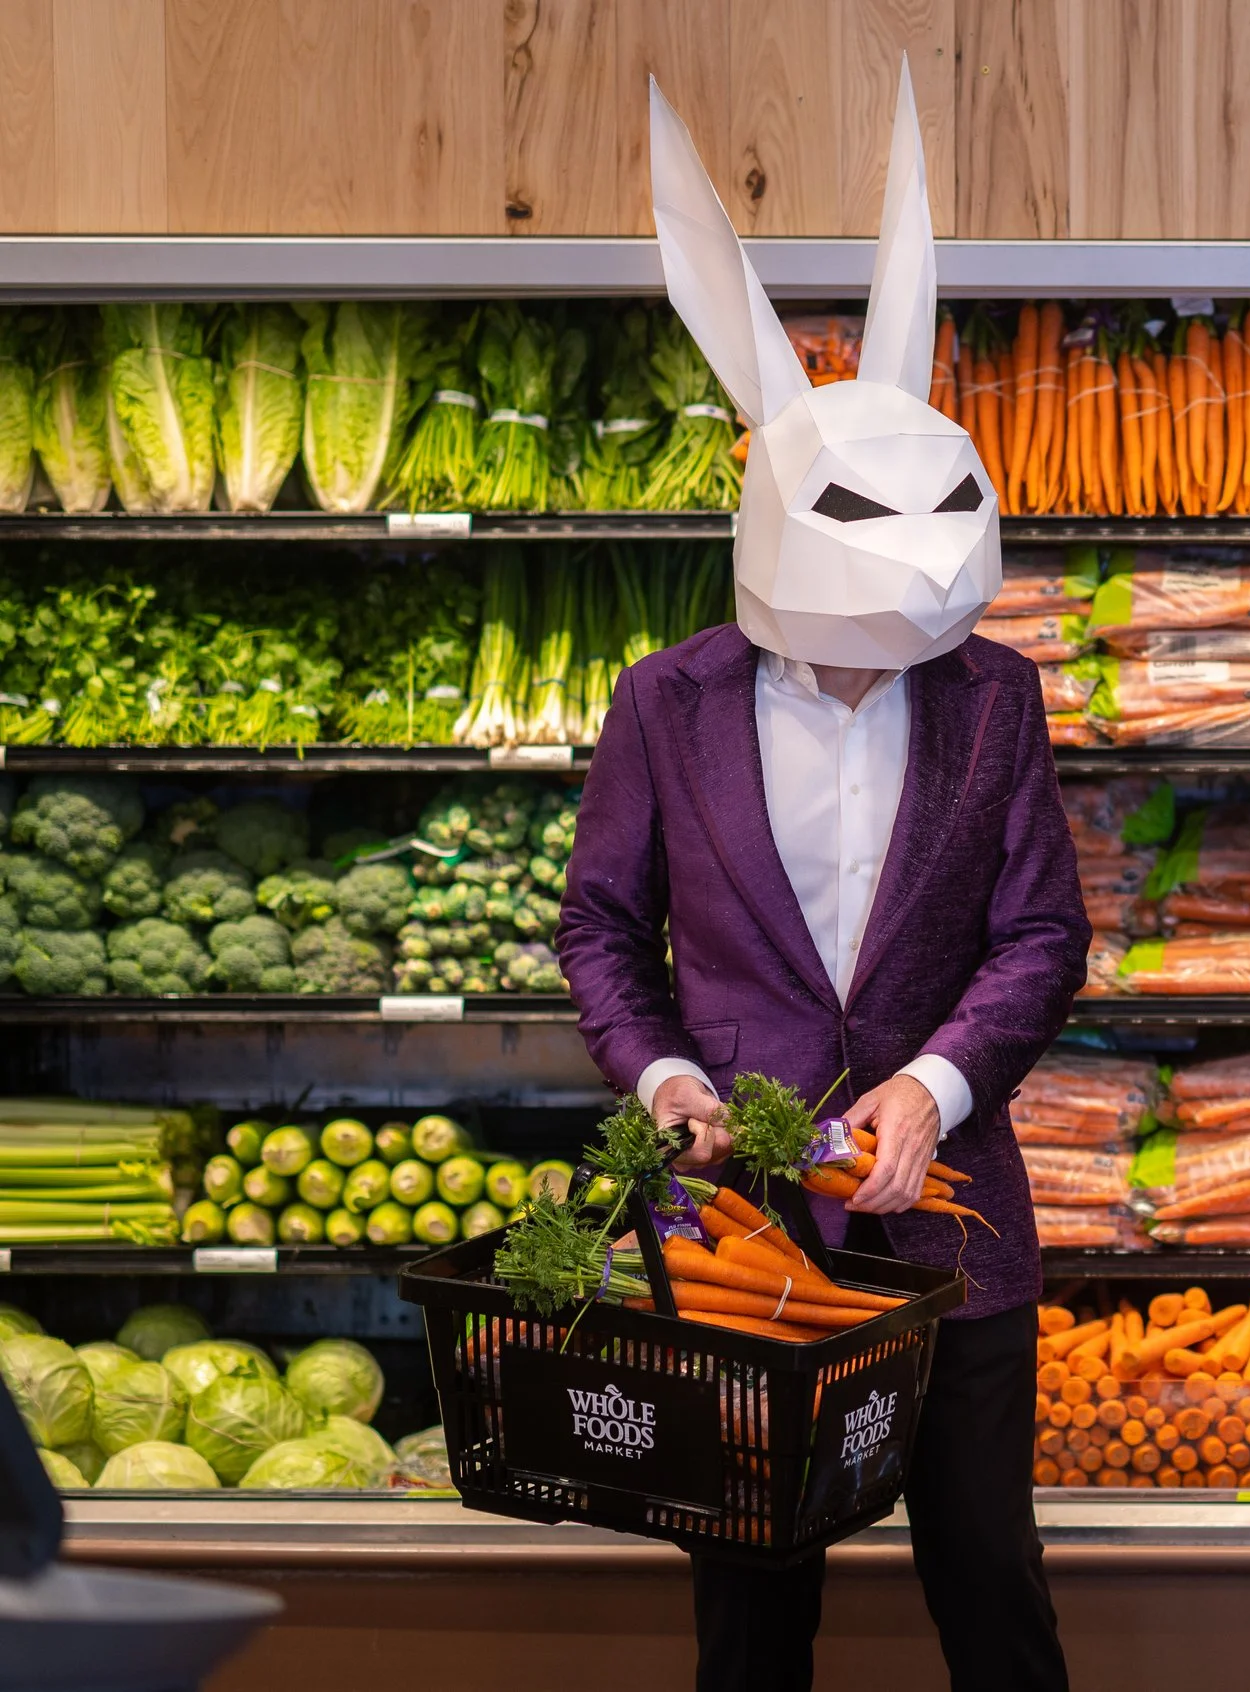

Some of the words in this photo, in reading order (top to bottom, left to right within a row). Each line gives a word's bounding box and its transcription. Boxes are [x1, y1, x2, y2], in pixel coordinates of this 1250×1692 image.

[566, 1385, 656, 1426] WHOLE
[844, 1391, 898, 1434] WHOLE
[572, 1413, 655, 1449] FOODS
[584, 1440, 643, 1460] MARKET
[840, 1416, 892, 1459] FOODS
[843, 1444, 881, 1469] MARKET
